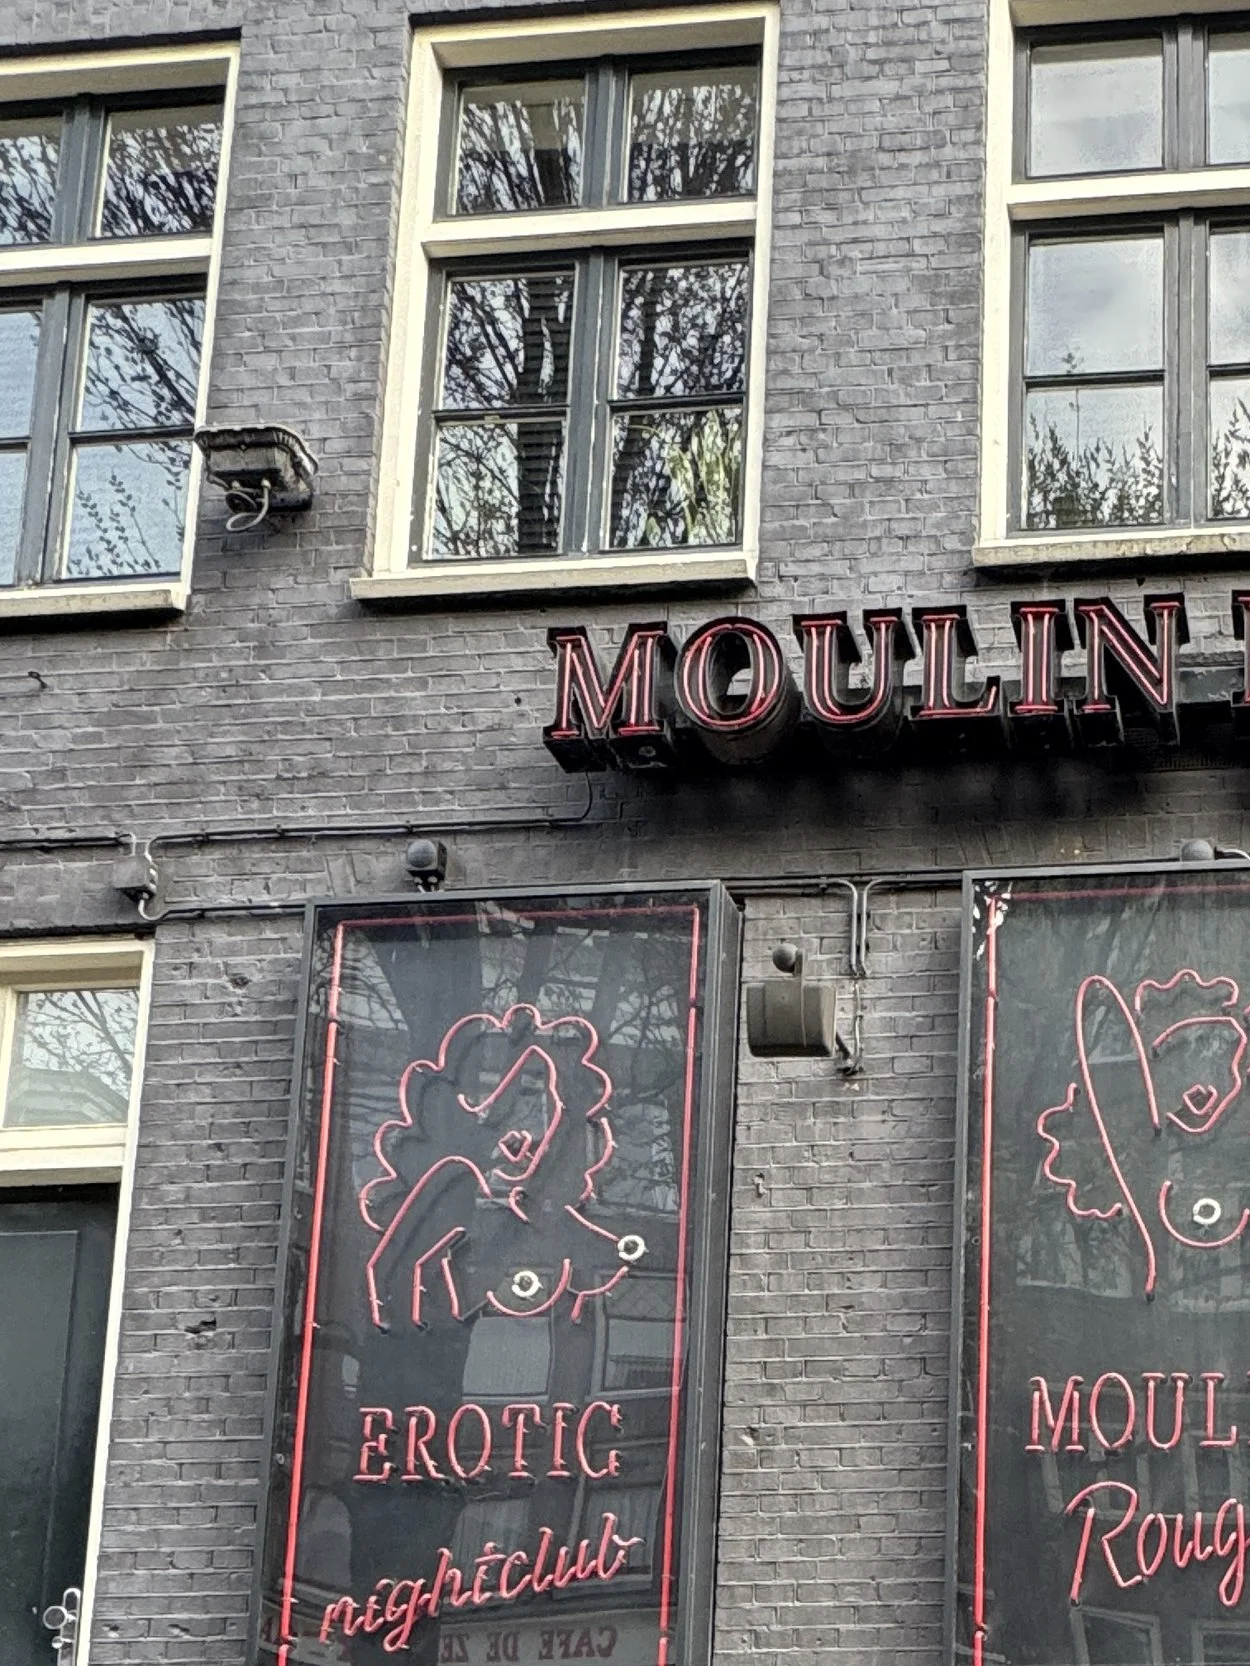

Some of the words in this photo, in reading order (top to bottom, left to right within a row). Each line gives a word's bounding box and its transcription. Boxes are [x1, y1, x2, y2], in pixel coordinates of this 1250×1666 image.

[545, 592, 1186, 770] MOULIN
[353, 1401, 624, 1484] EROTIC
[318, 1511, 646, 1652] nightclub
